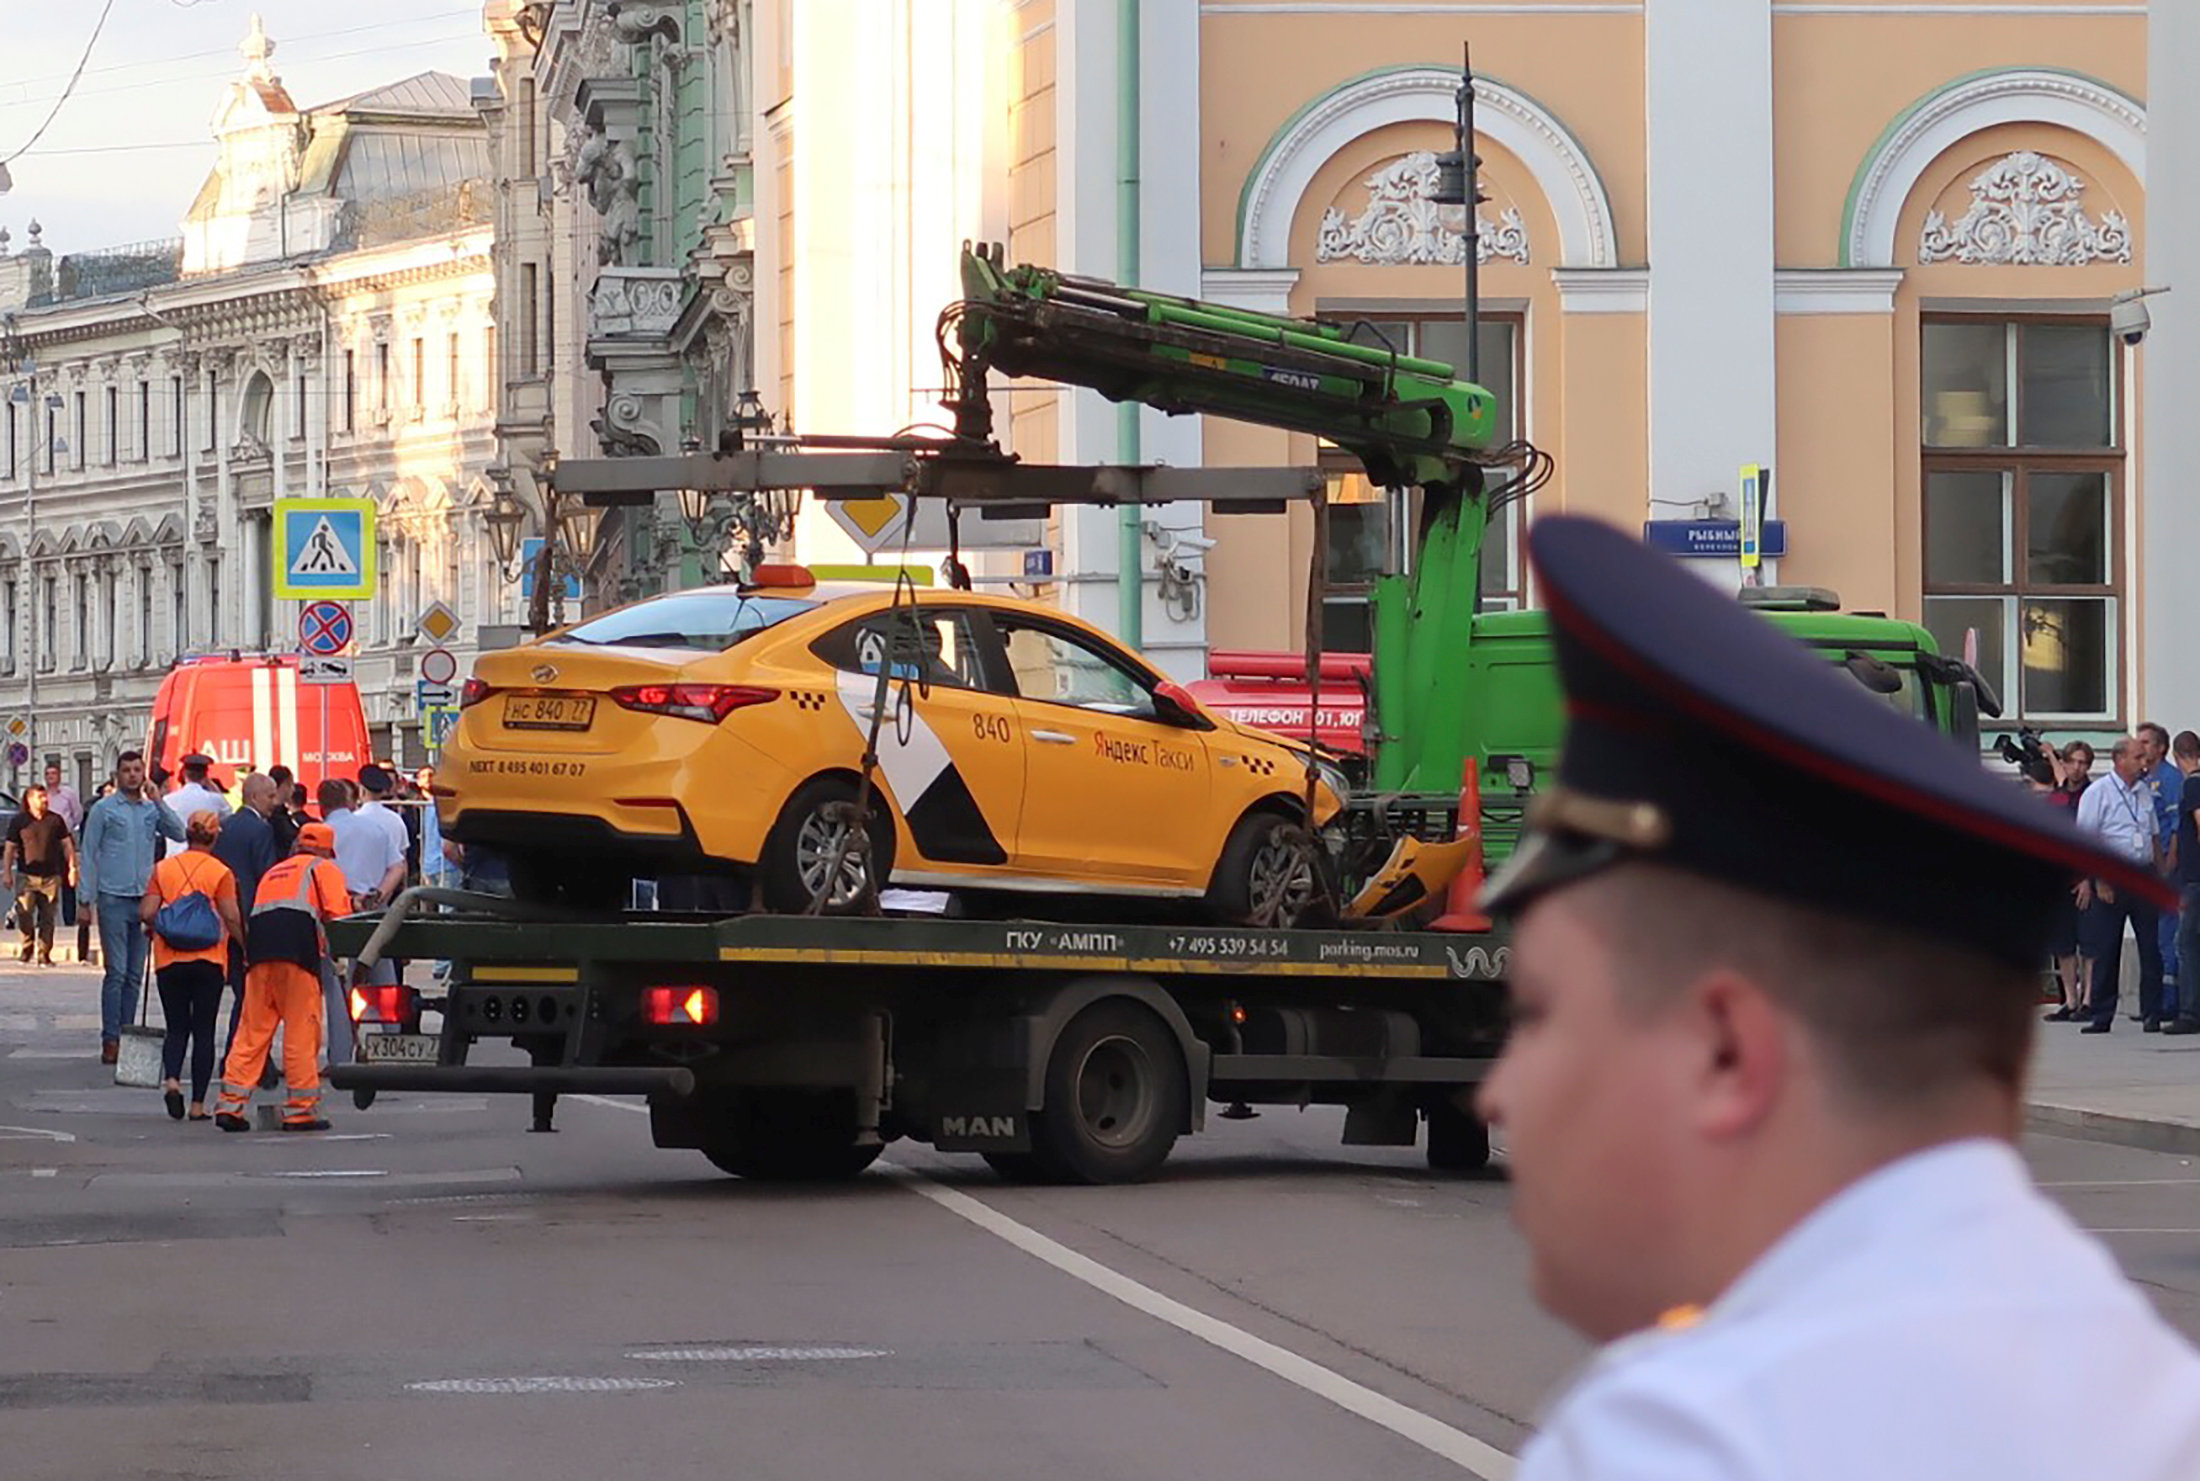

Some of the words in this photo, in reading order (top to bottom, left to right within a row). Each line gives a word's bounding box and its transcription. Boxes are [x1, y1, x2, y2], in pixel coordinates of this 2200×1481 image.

[535, 700, 563, 720] 840
[1229, 709, 1304, 725] ТЕЛЕФОН
[973, 713, 1010, 743] 840
[201, 739, 249, 763] АШ
[1094, 731, 1148, 765] Яндекс
[1152, 739, 1195, 771] Такси
[469, 760, 494, 773] NEXT
[507, 761, 526, 774] 495
[530, 762, 548, 775] 401
[552, 763, 567, 775] 67
[569, 763, 585, 776] 07
[1006, 931, 1042, 949] ГКУ
[1169, 936, 1185, 953] +7
[1189, 938, 1216, 954] 495
[1219, 938, 1247, 955] 539
[1249, 939, 1267, 955] 54
[1270, 940, 1288, 956] 54
[1320, 939, 1419, 961] parking.mos.ru
[942, 1116, 1015, 1137] MAN
